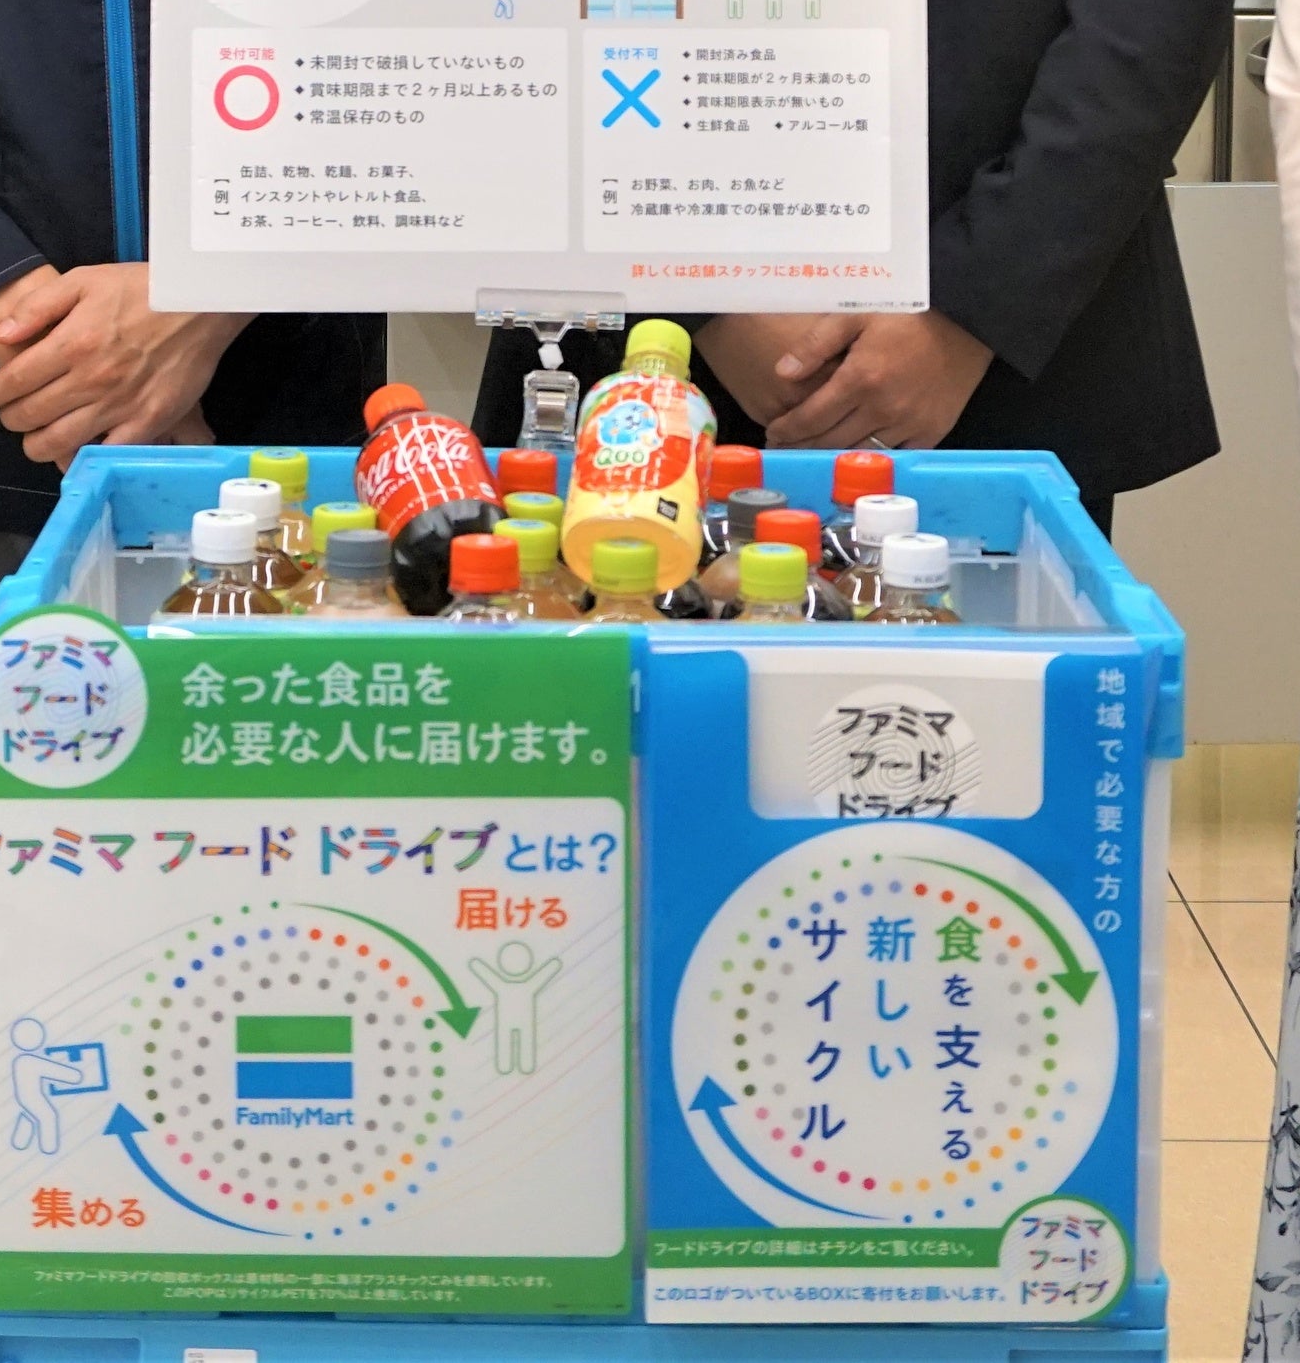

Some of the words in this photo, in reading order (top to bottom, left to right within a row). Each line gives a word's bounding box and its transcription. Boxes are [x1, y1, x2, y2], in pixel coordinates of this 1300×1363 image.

[219, 47, 276, 61] 受付可能
[310, 54, 526, 72] 未開封で破損していないもの
[603, 47, 660, 61] 受付不可
[696, 48, 778, 62] 開封済み食品
[696, 94, 845, 109] 賞味期限表示が無いもの
[309, 108, 426, 125] 常温保存のもの
[696, 118, 751, 133] 生鮮食品
[788, 118, 869, 133] アルコール類
[240, 189, 429, 204] インスタントやレトルト食品、
[630, 177, 786, 192] お野菜、お肉、お魚など
[240, 214, 465, 229] お茶、コーヒー、飲料、調味料など
[630, 202, 871, 217] 冷蔵庫や冷凍庫での保管が必要なもの
[631, 263, 893, 279] 詳しくは店舗スタッフにお尋ねください。
[1, 637, 119, 671] ファミマ
[181, 662, 452, 708] 余った食品を
[12, 681, 109, 717] フード
[836, 705, 955, 740] ファミマ
[0, 726, 126, 764] ドライブ
[181, 720, 610, 767] 必要な人に届けます。
[848, 749, 943, 783] フード
[1093, 666, 1127, 935] 地域で必要な方の
[154, 825, 296, 876] フード
[455, 888, 569, 931] 届ける
[866, 915, 917, 1080] 新しい
[799, 917, 848, 1143] サイクル
[934, 916, 984, 1162] 食を支える
[235, 1107, 355, 1128] FamilyMart
[32, 1188, 148, 1230] 集める
[1021, 1215, 1107, 1241] ファミマ
[654, 1239, 975, 1259] フードドライブの詳細はチラシをご覧ください。
[1028, 1248, 1099, 1274] フード
[653, 1284, 1006, 1305] このロゴがついているBOXに寄付をお願いします。
[1019, 1279, 1110, 1306] ドライブ
